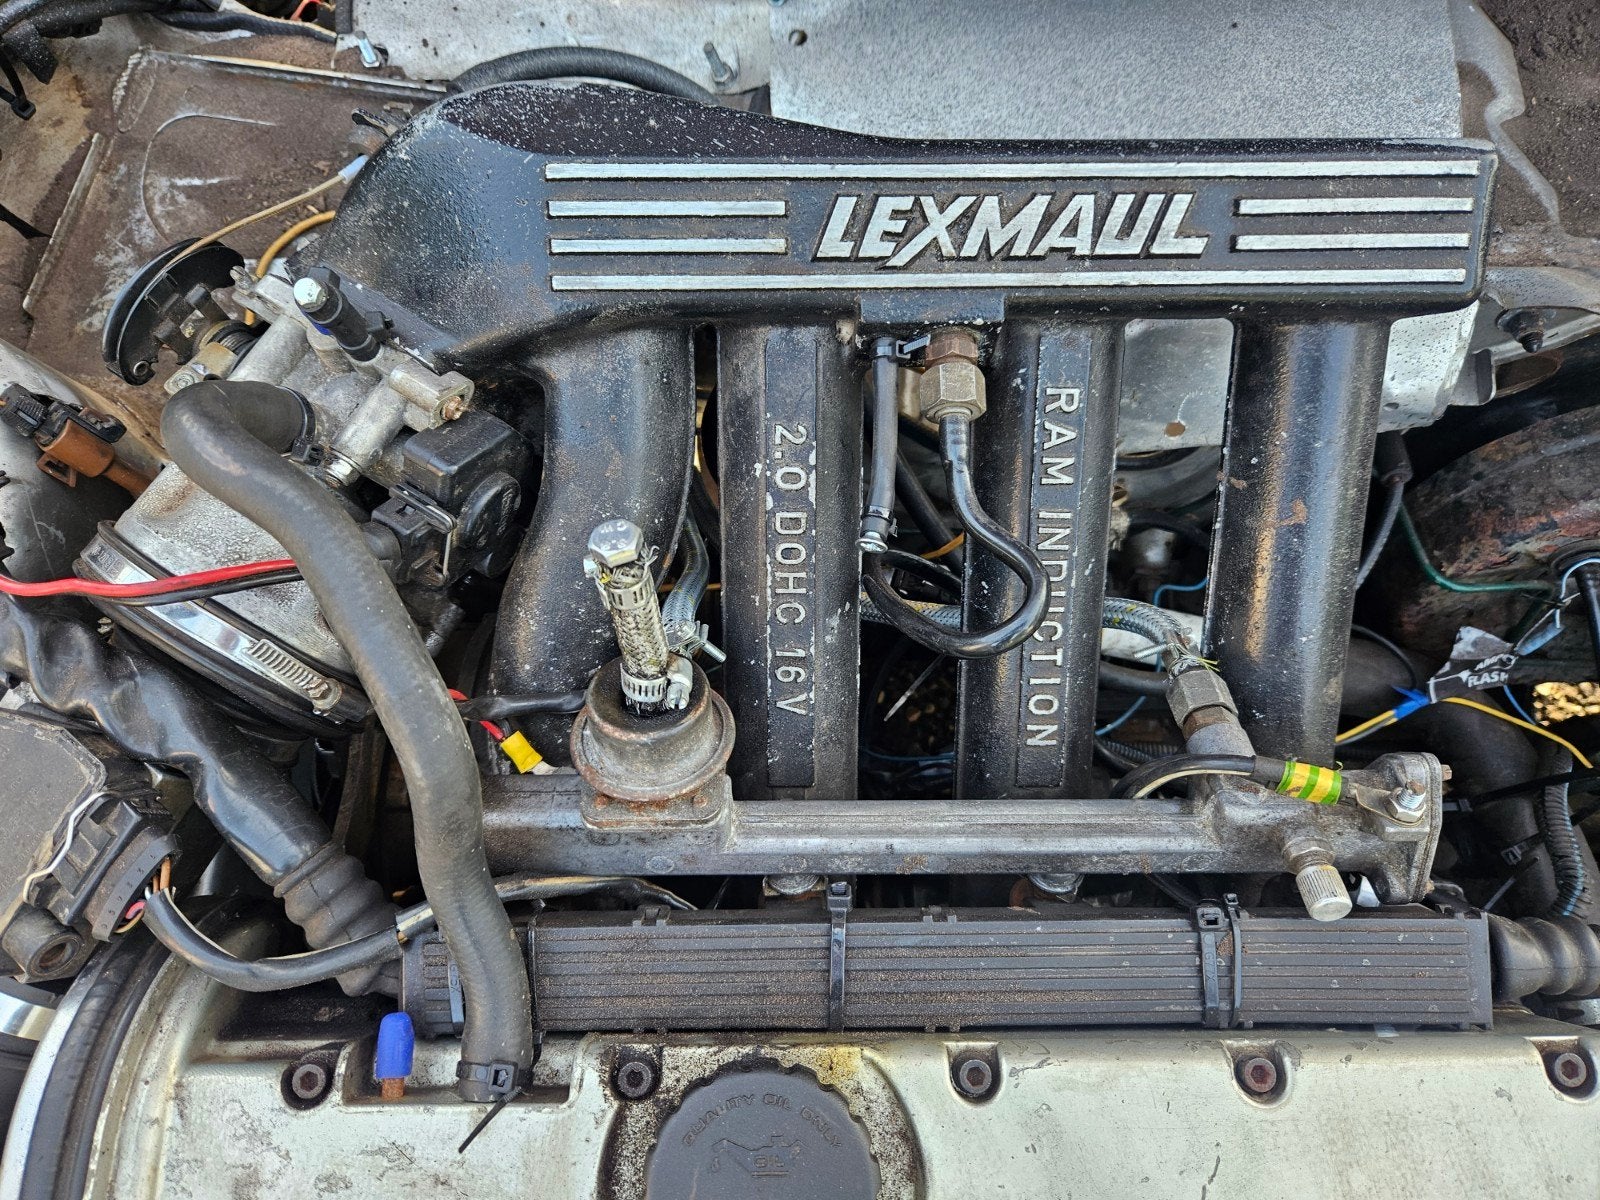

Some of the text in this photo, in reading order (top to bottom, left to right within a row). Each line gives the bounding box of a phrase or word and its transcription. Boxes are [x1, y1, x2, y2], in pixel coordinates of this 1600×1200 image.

[814, 194, 1209, 269] LEXMAUL
[1039, 387, 1079, 486] RAM
[773, 423, 808, 716] 2.0 DOHC 16V
[1468, 671, 1509, 688] FLASH
[682, 1093, 842, 1147] QUALITY OIL ONLY
[754, 1155, 785, 1168] OIL
